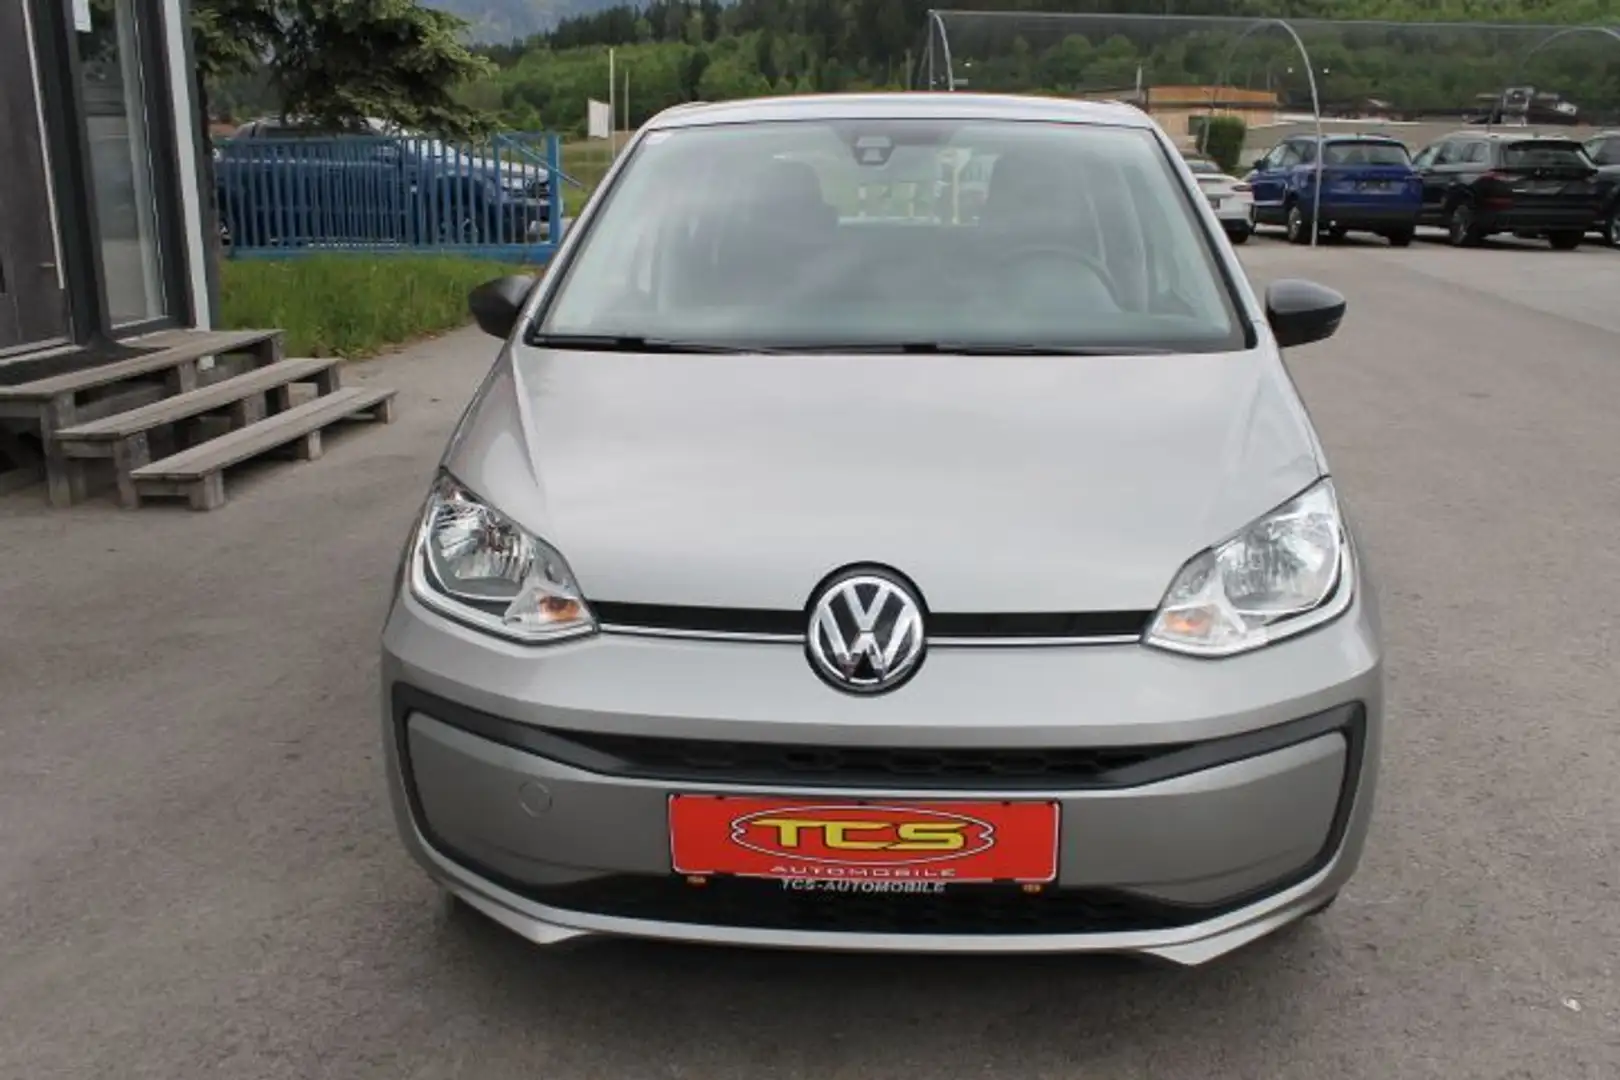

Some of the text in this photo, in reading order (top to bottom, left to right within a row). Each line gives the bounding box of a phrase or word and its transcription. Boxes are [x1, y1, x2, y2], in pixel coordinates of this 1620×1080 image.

[751, 819, 970, 850] TCS
[769, 865, 957, 877] AUTOMOBILE
[781, 878, 947, 893] TCS-AUTOMOBILE
